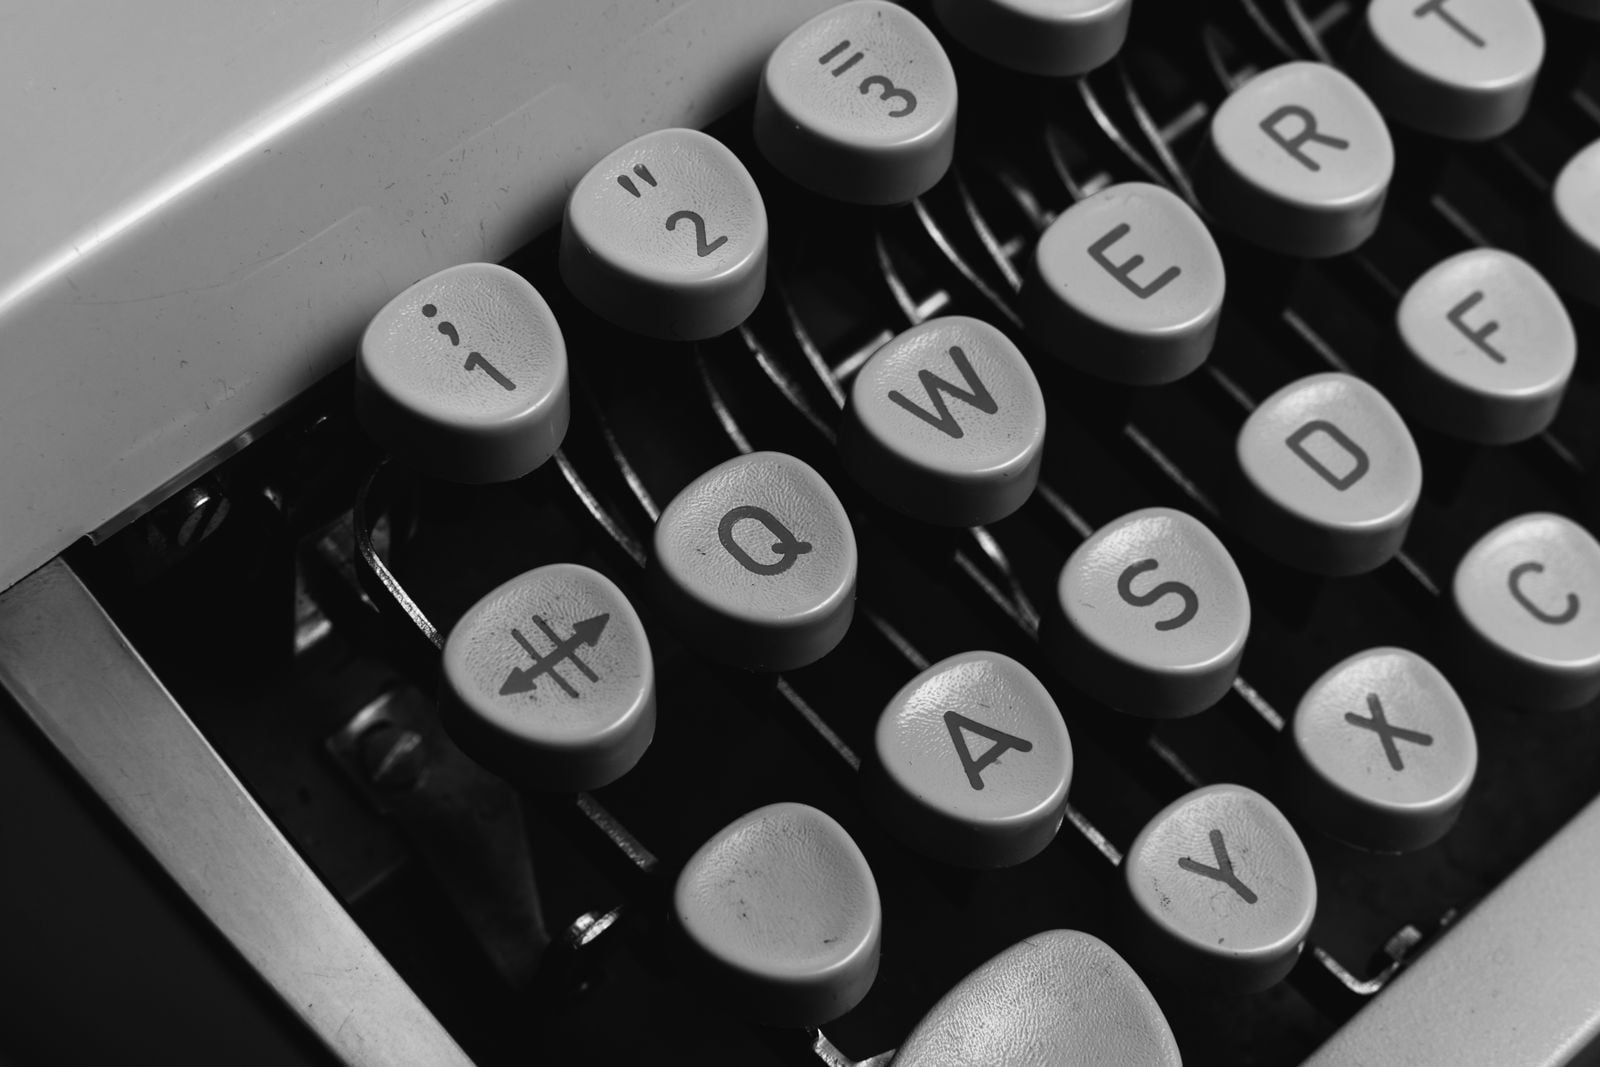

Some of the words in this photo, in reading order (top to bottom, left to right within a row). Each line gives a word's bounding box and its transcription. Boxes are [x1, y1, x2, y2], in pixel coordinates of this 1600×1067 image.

[859, 75, 917, 117] 3
[1259, 105, 1349, 171] R
[665, 210, 728, 257] 2
[1088, 223, 1181, 299] E
[1447, 291, 1506, 364] F
[463, 352, 516, 391] 1
[888, 346, 998, 439] W
[1286, 420, 1369, 491] D
[718, 506, 812, 576] Q
[1118, 559, 1199, 631] S
[1508, 562, 1580, 625] C
[944, 711, 1033, 790] A
[1345, 694, 1433, 771] X
[1178, 830, 1258, 904] Y
